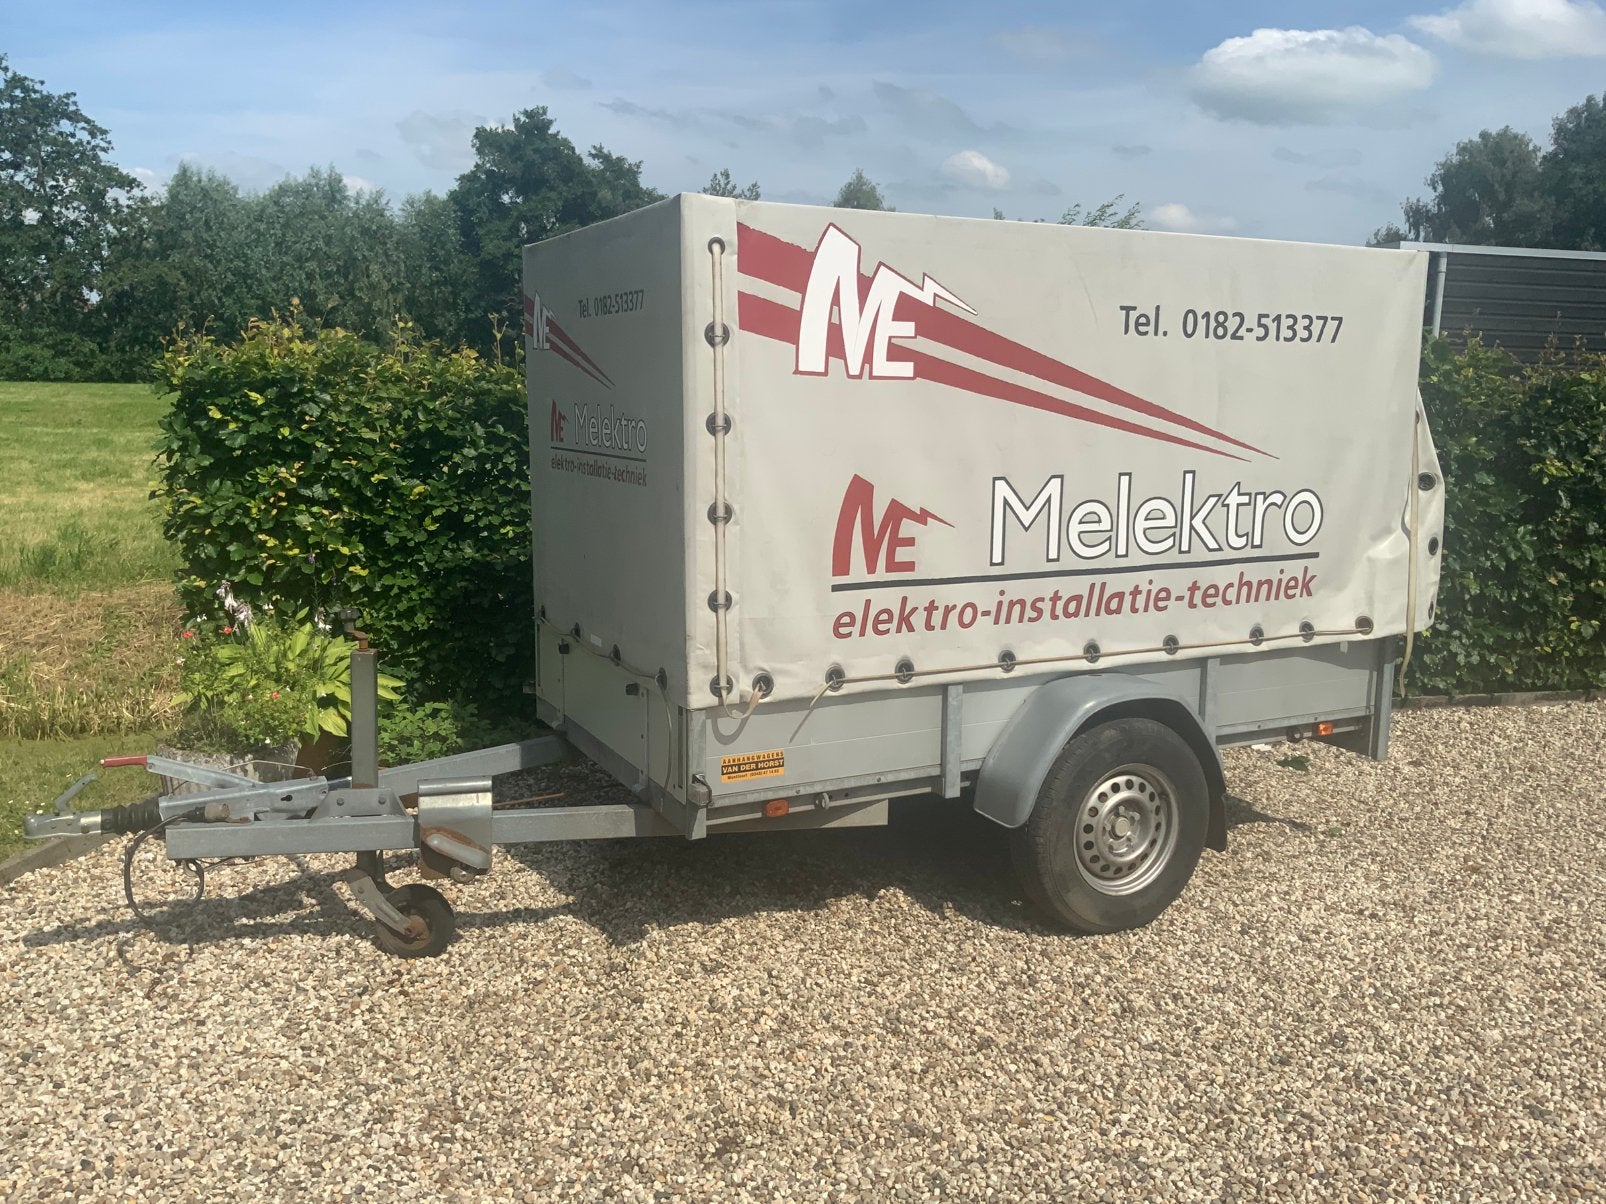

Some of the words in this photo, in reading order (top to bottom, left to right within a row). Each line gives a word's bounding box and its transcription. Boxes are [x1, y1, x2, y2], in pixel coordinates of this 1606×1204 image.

[578, 297, 592, 319] Tel.
[594, 290, 645, 317] 0182-513377
[1119, 305, 1168, 338] Tel.
[1181, 309, 1344, 344] 0182-513377
[574, 403, 647, 453] Melektro
[551, 454, 647, 487] elektro-installatie-techniek
[989, 470, 1324, 567] Melektro
[832, 567, 1318, 639] elektro-installatie-techniek
[722, 752, 784, 764] AANHANGWAGENS
[758, 759, 784, 769] HORST
